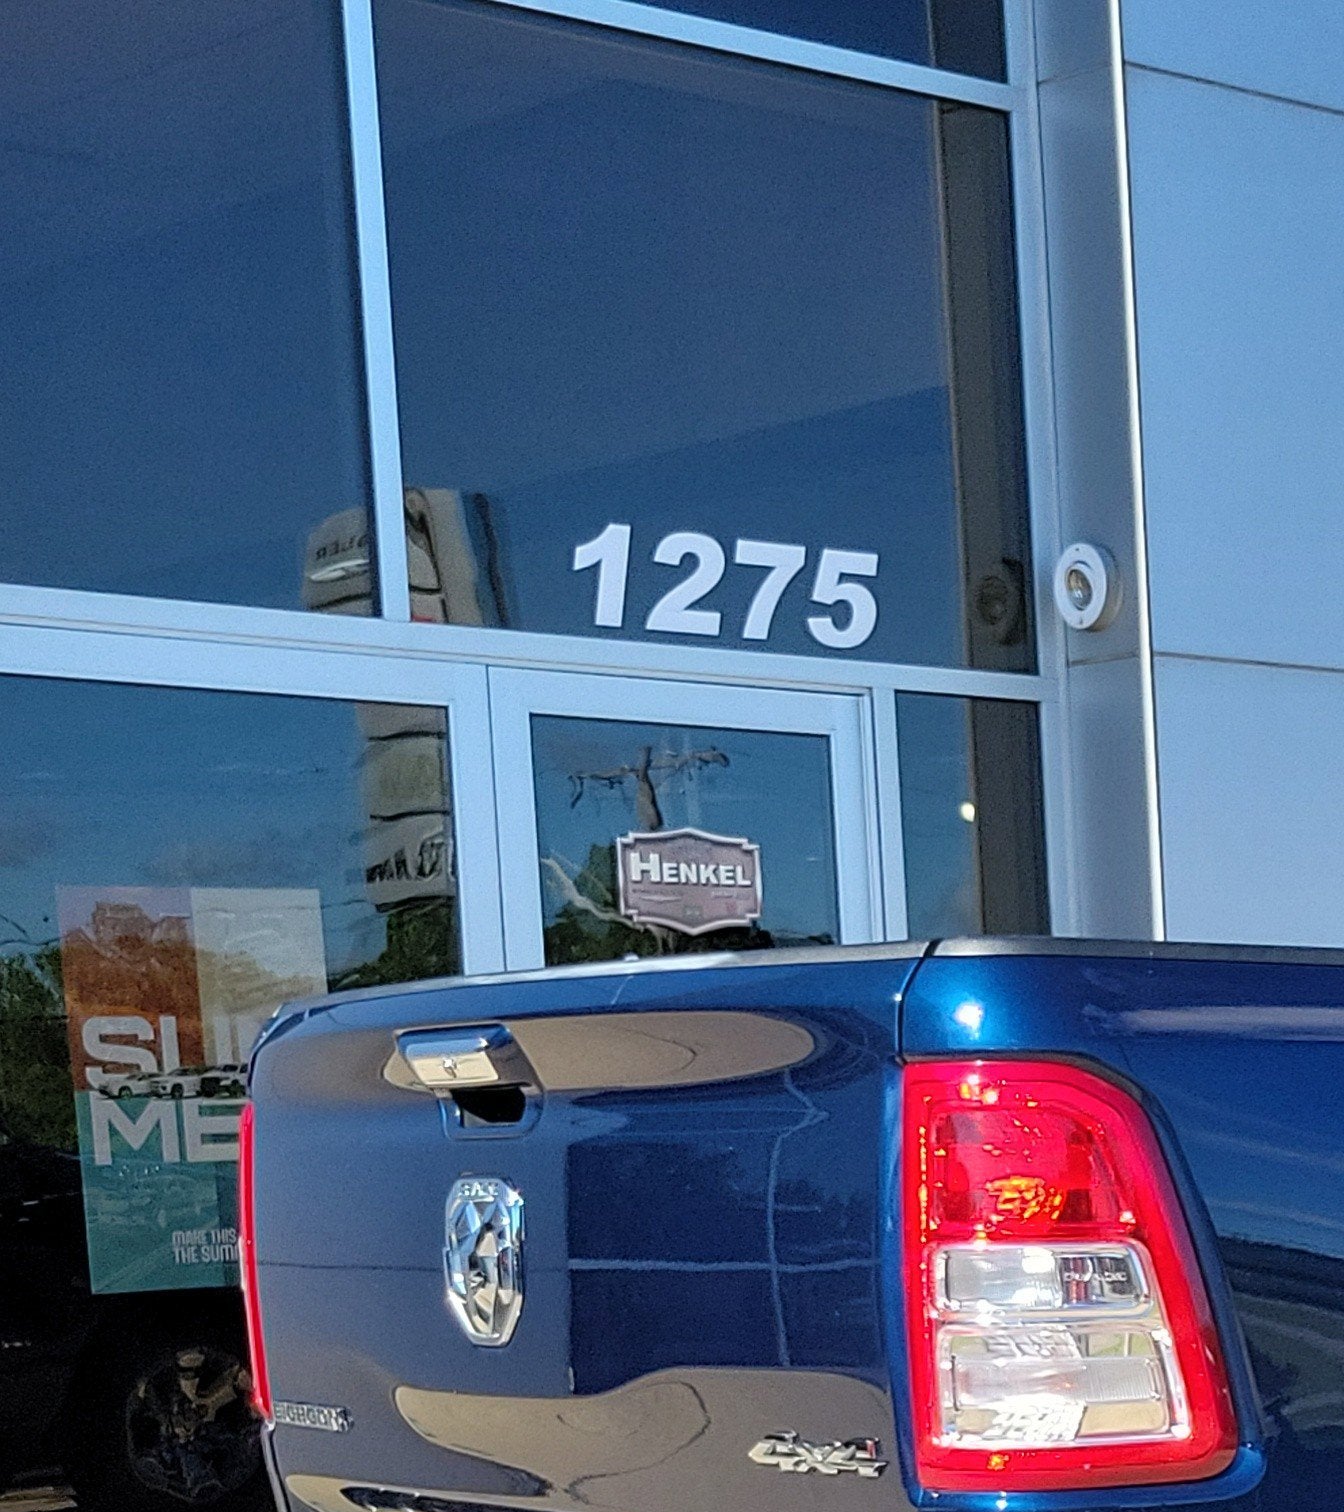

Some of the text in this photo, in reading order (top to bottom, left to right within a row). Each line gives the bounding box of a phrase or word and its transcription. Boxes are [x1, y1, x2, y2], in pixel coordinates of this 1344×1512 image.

[573, 522, 878, 650] 1275
[172, 1227, 238, 1246] MAKE THIS
[173, 1245, 200, 1265] THE
